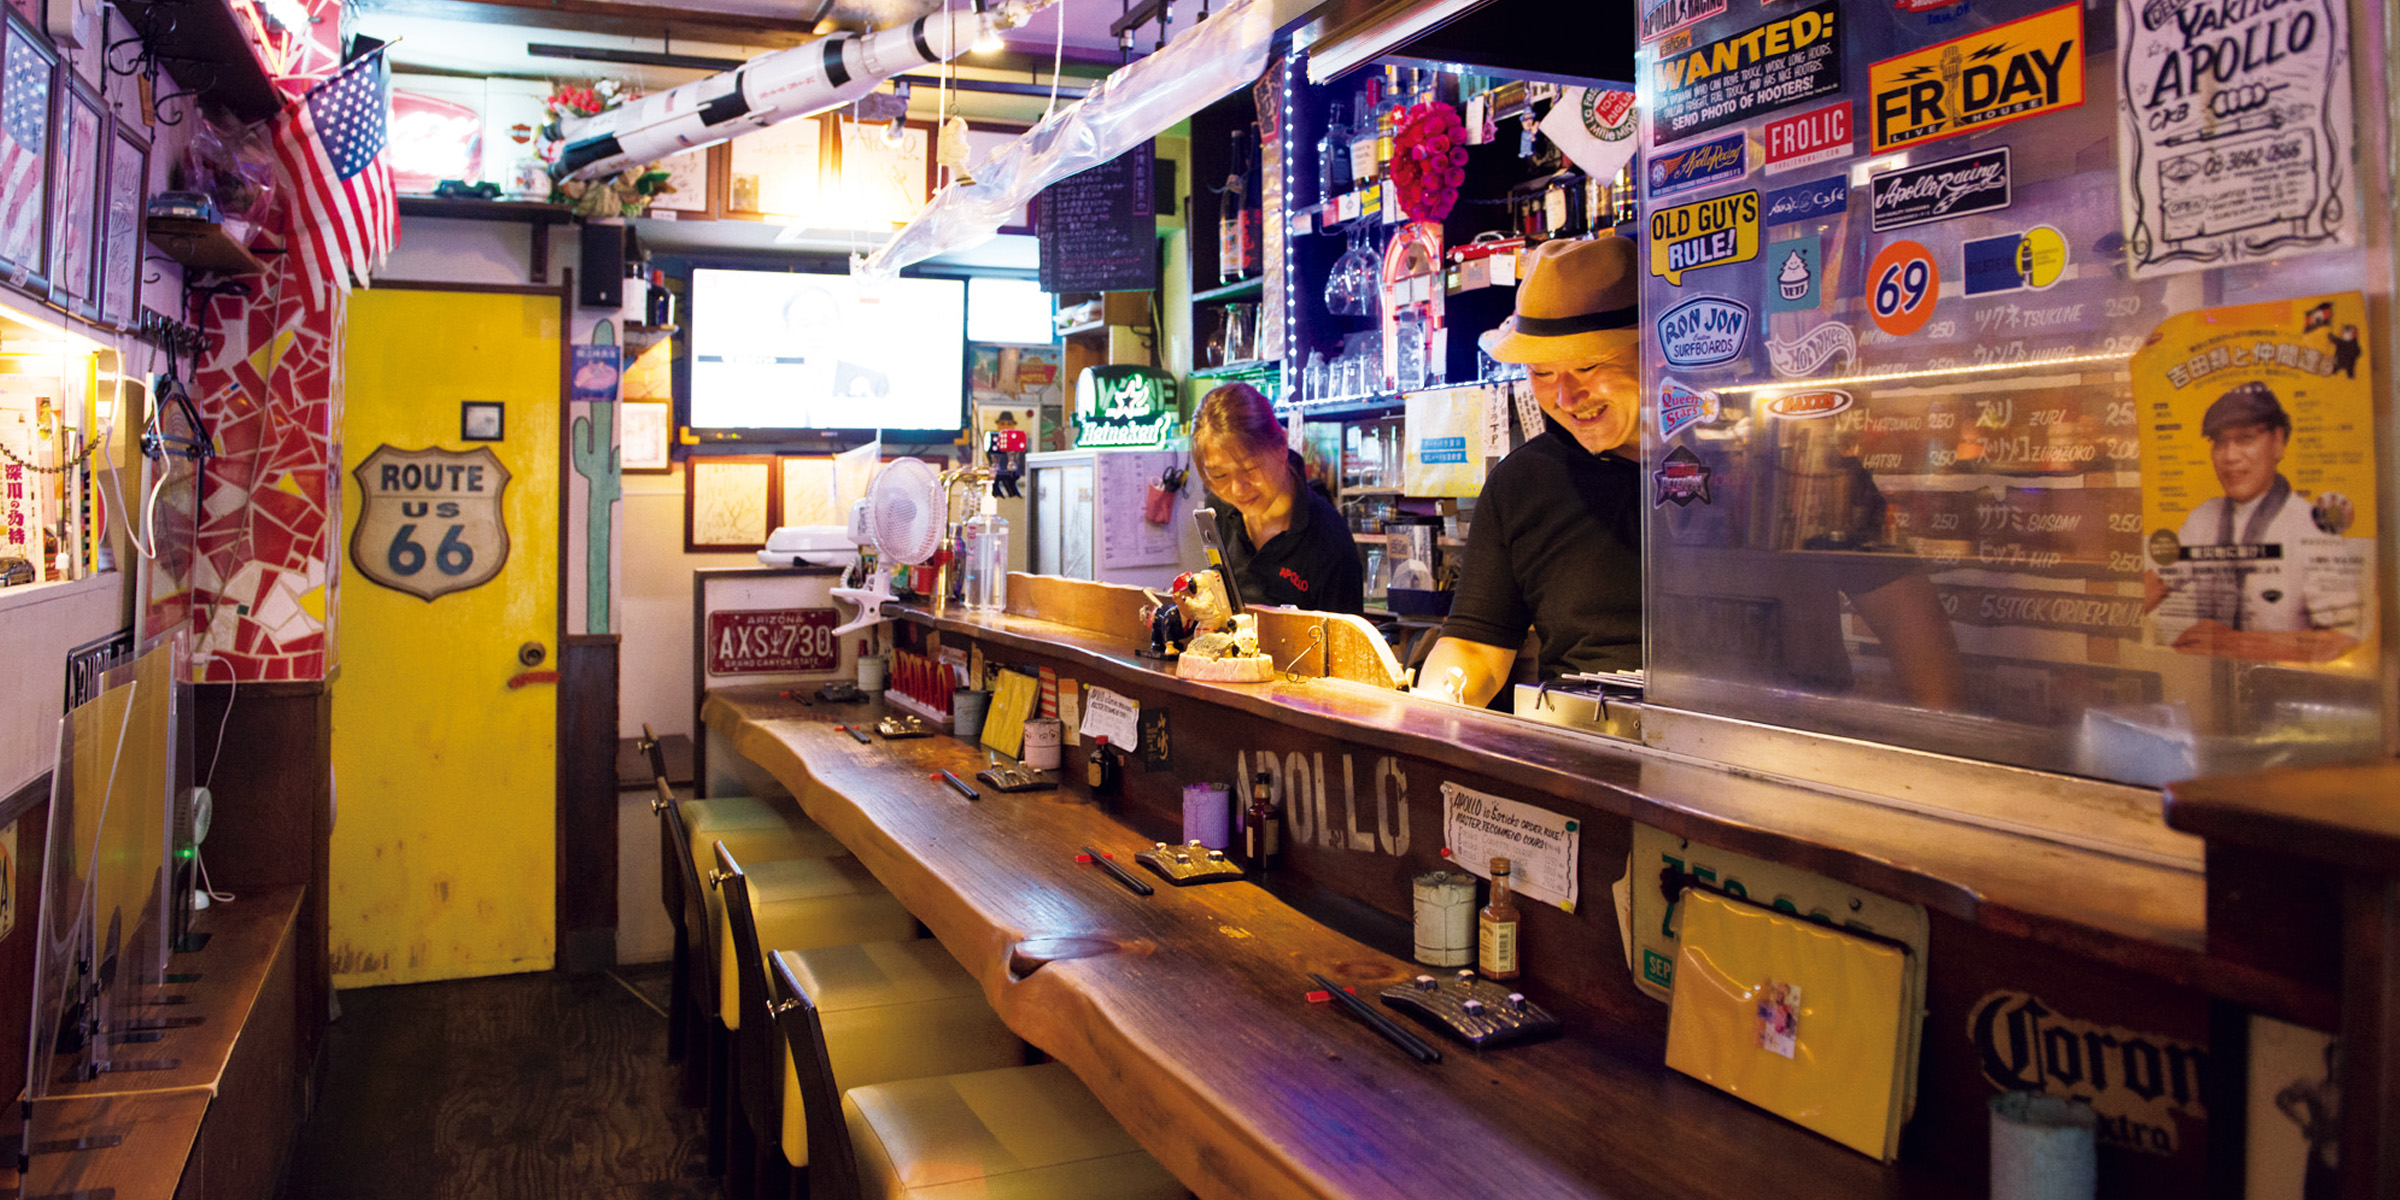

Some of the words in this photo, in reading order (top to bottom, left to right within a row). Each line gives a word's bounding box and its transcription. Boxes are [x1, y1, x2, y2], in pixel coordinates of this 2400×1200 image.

[1655, 11, 1834, 92] WANTED:
[1765, 59, 1786, 74] WORK
[1788, 53, 1805, 67] LONG
[2144, 11, 2315, 108] APOLLO
[1672, 111, 1699, 131] SEND
[1701, 96, 1737, 122] PHOTO
[1740, 92, 1753, 109] OF
[1757, 75, 1814, 104] HOOTERS!
[1771, 109, 1844, 158] FROLIC
[1893, 125, 1937, 142] LIVE
[1972, 99, 2041, 122] HOUSE
[1653, 210, 1689, 240] OLD
[1698, 194, 1756, 232] GUYS
[1669, 228, 1735, 270] RULE!
[1783, 285, 1805, 297] YETI
[1875, 258, 1930, 317] 69
[1666, 308, 1700, 345] RON
[1704, 308, 1742, 334] JON
[1974, 303, 2021, 332] ツクネ
[2023, 303, 2084, 327] TSUKUNE
[2105, 299, 2140, 318] 250
[1928, 321, 1955, 339] 250
[1673, 339, 1733, 358] SURFBOARDS
[1097, 377, 1178, 412] WNE
[1662, 391, 1699, 408] Queen
[1078, 415, 1165, 446] Heineken
[1666, 407, 1698, 427] Stars
[1928, 413, 1955, 429] 250
[2029, 408, 2067, 427] ZURI
[1863, 454, 1902, 469] HATSU
[1930, 449, 1957, 467] 250
[2031, 444, 2096, 463] ZURIZOKO
[381, 464, 483, 492] ROUTE
[402, 502, 460, 518] US
[1932, 513, 1959, 531] 250
[1975, 503, 2024, 532] ササミ
[2028, 513, 2083, 533] SASAMI
[2108, 513, 2142, 534] 250
[388, 525, 474, 576] 66
[2028, 552, 2062, 569] HIP
[2107, 551, 2143, 573] 250
[1279, 567, 1309, 592] APOLLO
[747, 615, 804, 625] ARIZONA
[719, 627, 769, 660] AXS
[783, 625, 830, 657] 730
[725, 658, 755, 668] GRAND
[756, 658, 792, 667] CANYON
[793, 656, 819, 666] STATE
[1454, 792, 1483, 816] APOLLO
[1483, 807, 1490, 818] is
[1521, 820, 1543, 836] ORDER
[1650, 956, 1671, 979] SEP
[1975, 996, 2208, 1106] Coron
